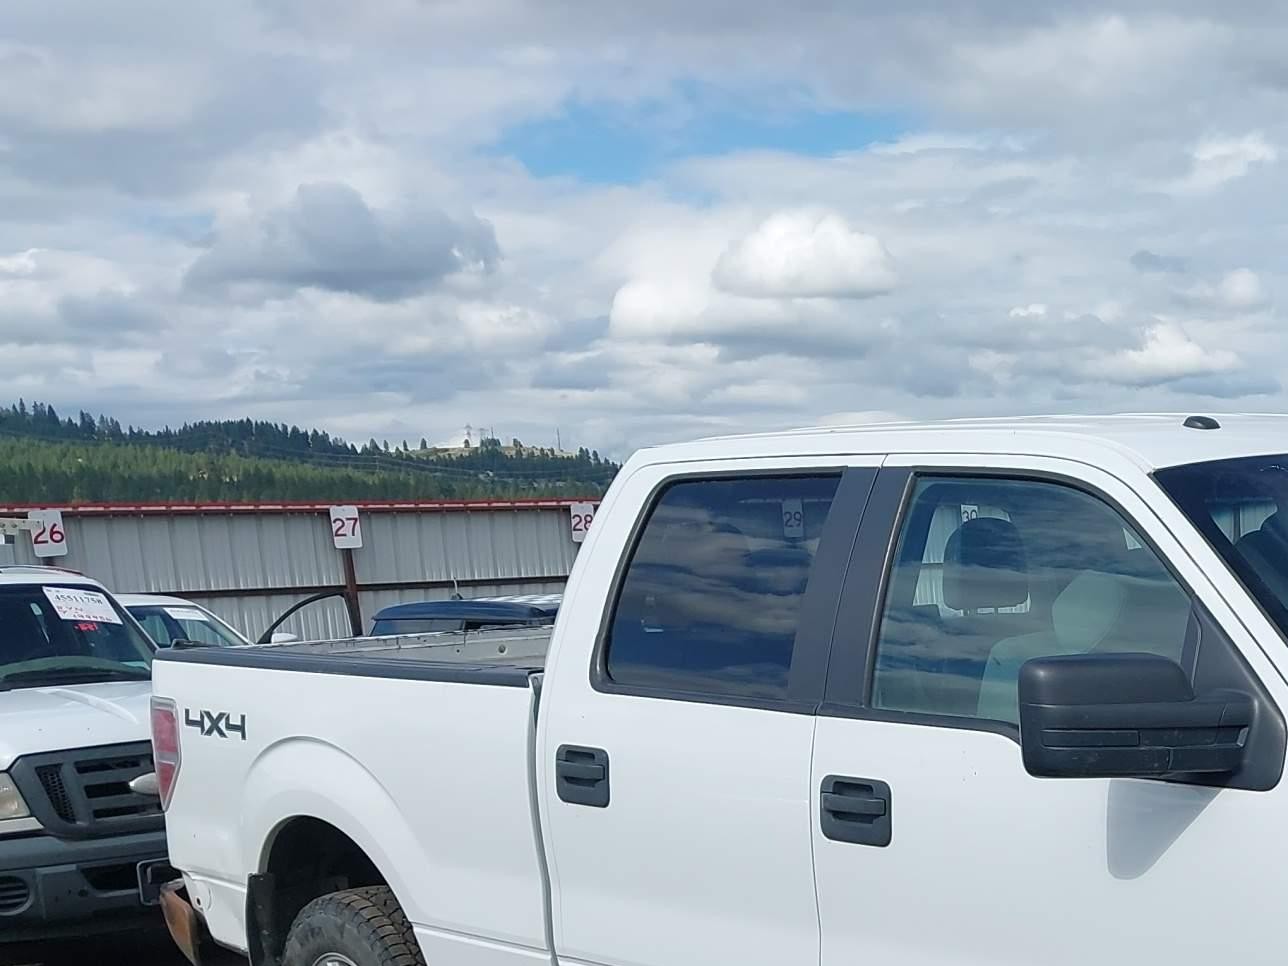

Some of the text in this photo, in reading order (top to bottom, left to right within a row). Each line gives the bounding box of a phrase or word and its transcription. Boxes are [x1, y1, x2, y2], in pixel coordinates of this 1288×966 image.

[332, 517, 358, 537] 27
[572, 513, 593, 532] 28
[784, 511, 802, 528] 29
[33, 520, 65, 544] 26
